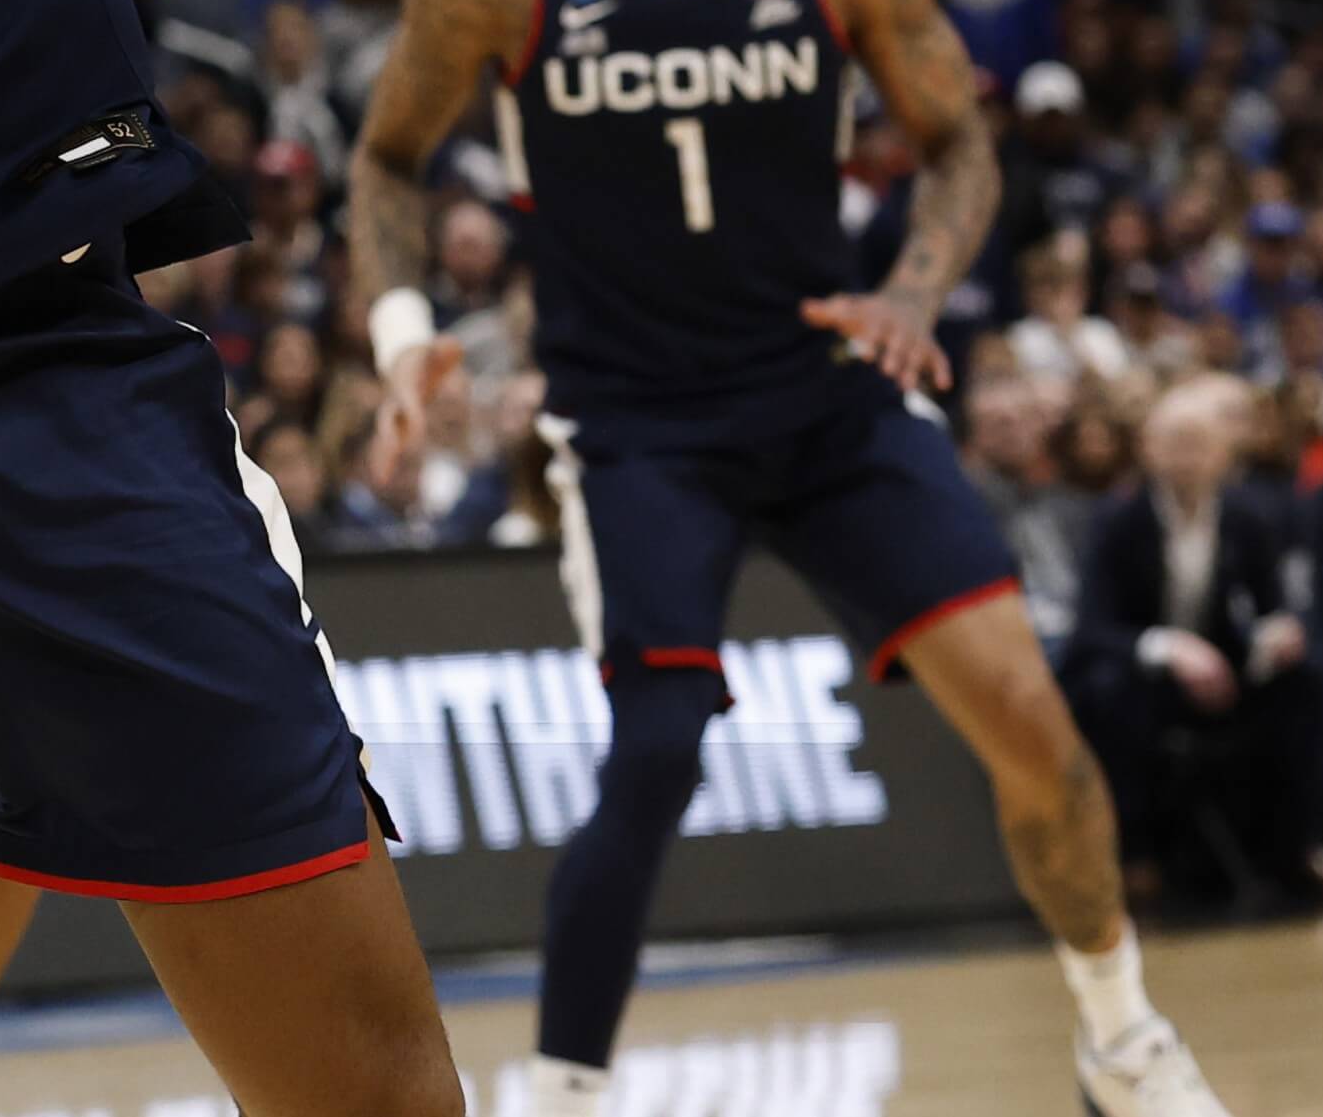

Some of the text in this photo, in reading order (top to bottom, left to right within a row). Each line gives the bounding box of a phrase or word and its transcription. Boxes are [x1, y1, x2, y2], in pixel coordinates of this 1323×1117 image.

[542, 34, 820, 117] UCONN
[107, 122, 134, 137] 52
[664, 118, 714, 233] 1
